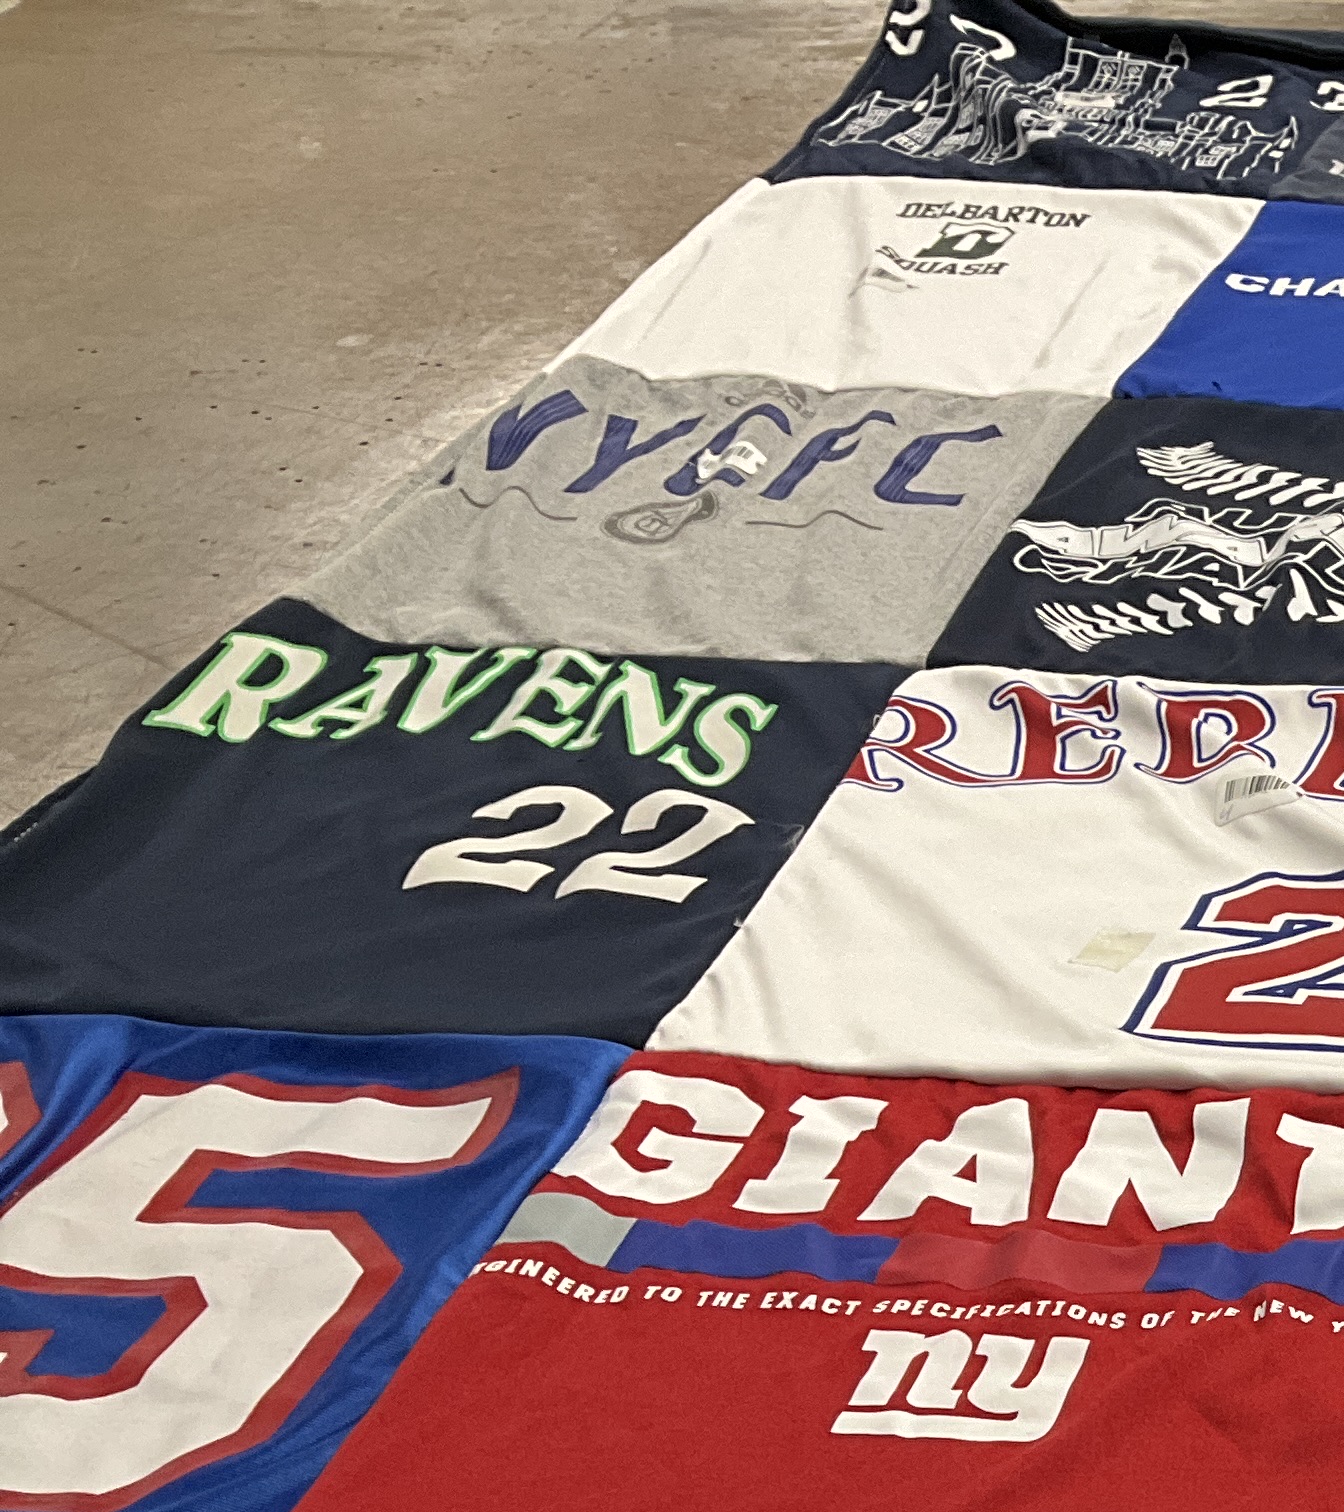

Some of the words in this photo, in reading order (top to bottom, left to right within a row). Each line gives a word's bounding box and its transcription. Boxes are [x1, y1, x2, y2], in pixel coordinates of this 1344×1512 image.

[896, 200, 1092, 229] DELBARTON
[875, 245, 1010, 276] SQUASH
[143, 631, 779, 787] RAVENS
[402, 785, 756, 904] 22
[643, 1285, 682, 1302] TO
[695, 1291, 750, 1310] THE
[759, 1291, 862, 1317] EXACT
[872, 1299, 1127, 1330] SPECIFICATIONS
[1140, 1310, 1176, 1329] OF
[1253, 1299, 1315, 1324] NEW
